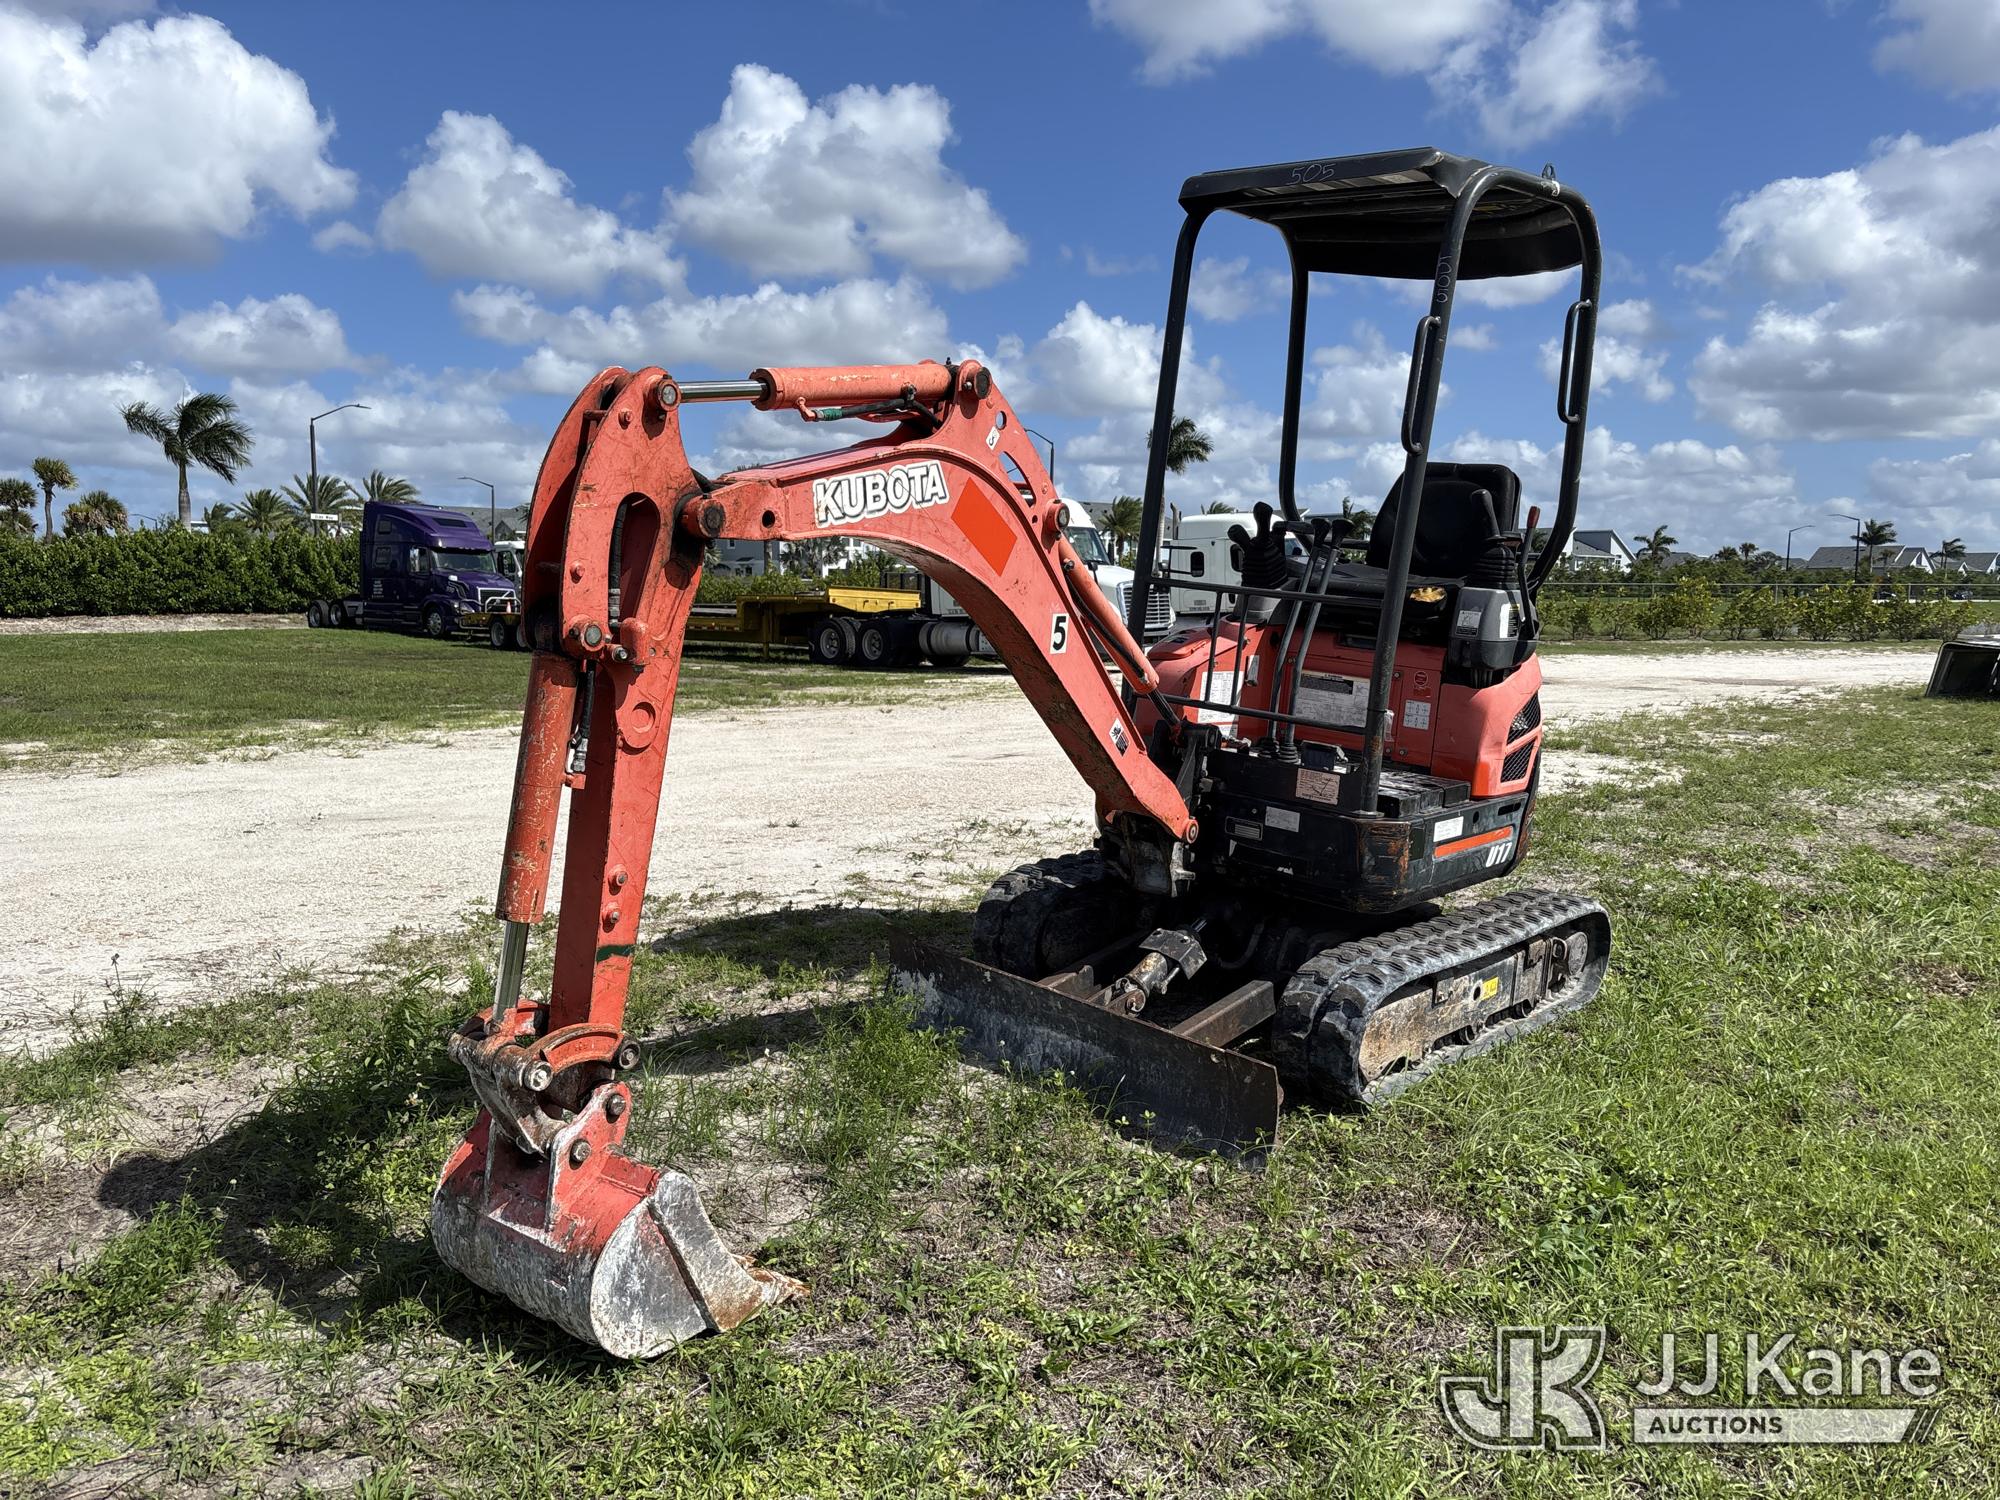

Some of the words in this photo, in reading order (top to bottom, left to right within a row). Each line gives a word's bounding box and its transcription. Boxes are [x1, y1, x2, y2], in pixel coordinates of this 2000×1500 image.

[1286, 163, 1337, 185] 505
[815, 462, 948, 524] KUBOTA
[1052, 615, 1067, 651] 5
[1485, 841, 1513, 868] U17
